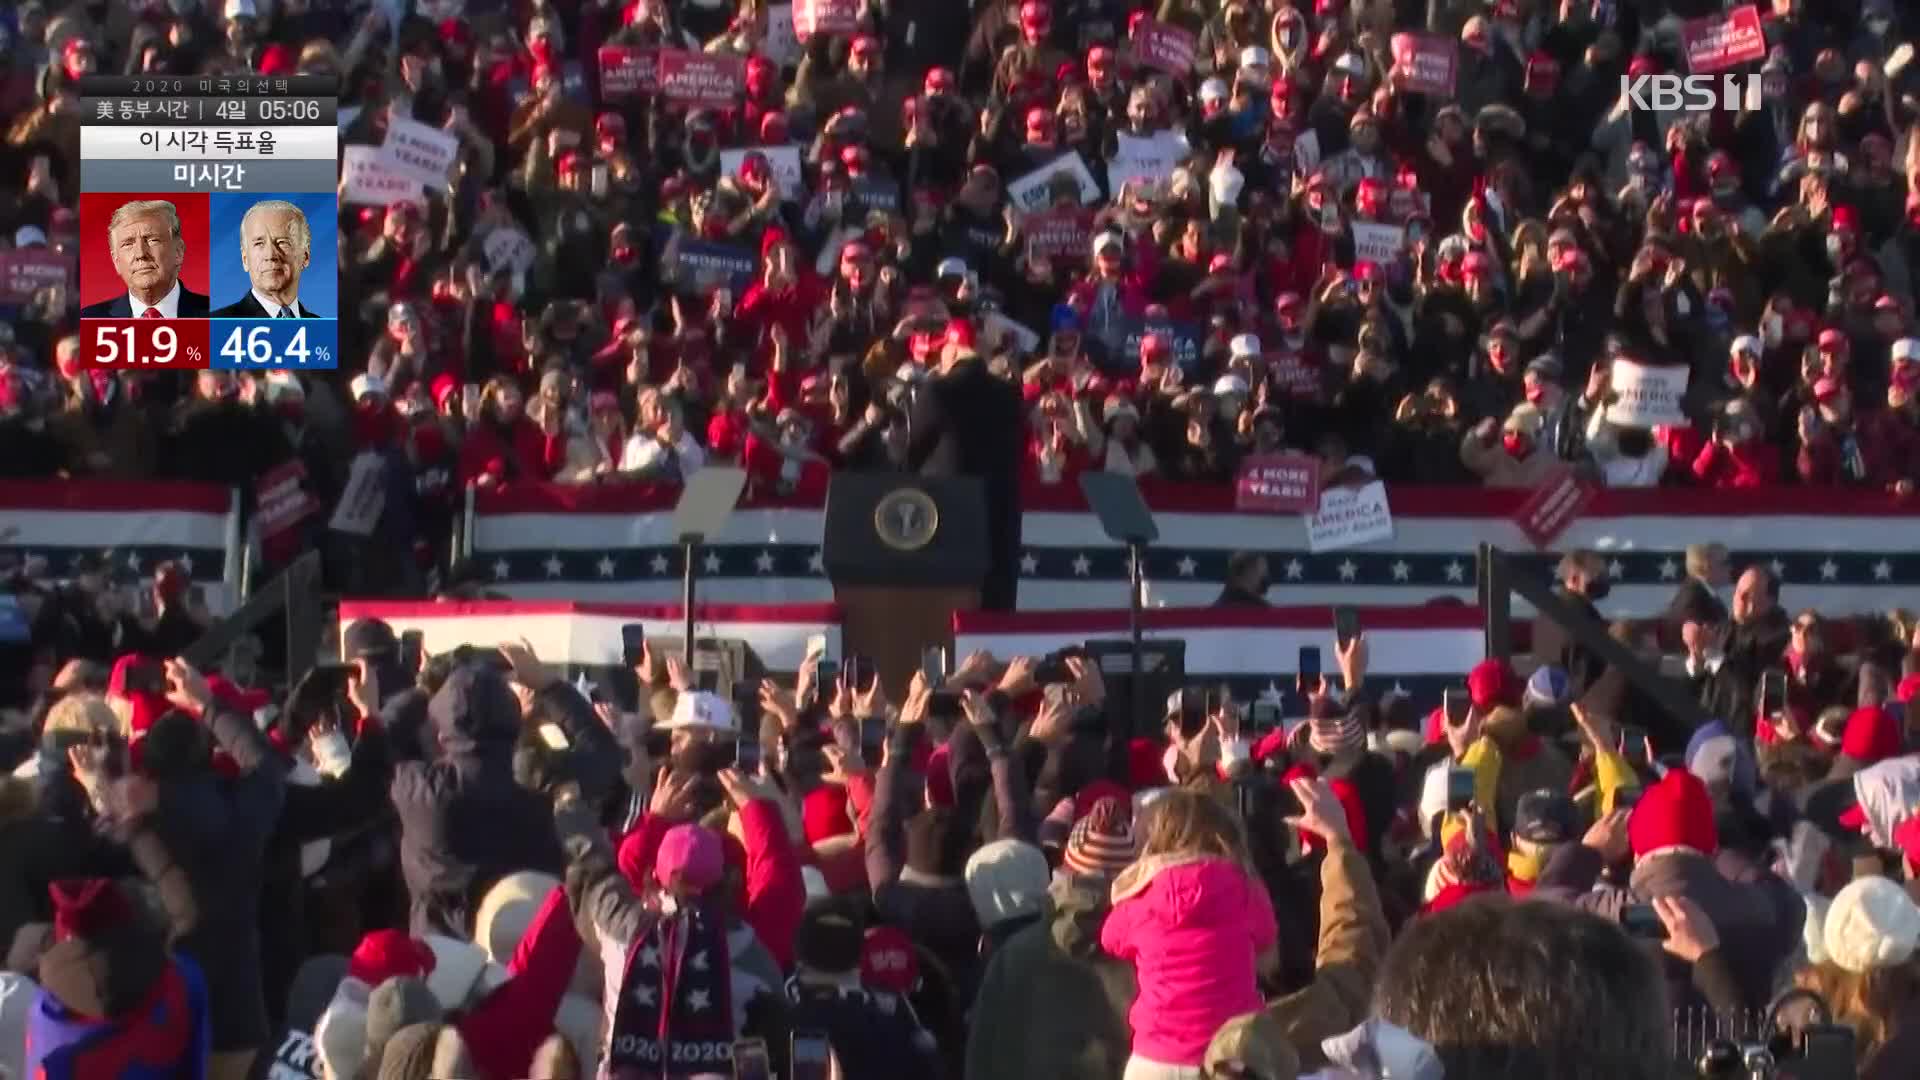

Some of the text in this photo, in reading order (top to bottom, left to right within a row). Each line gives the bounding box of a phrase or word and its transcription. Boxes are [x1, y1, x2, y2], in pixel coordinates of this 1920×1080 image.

[1690, 27, 1757, 52] AMERICA
[664, 73, 735, 88] AMERICA
[1248, 468, 1309, 482] 4 MORE
[1249, 483, 1307, 497] YEARS!
[1312, 500, 1384, 529] AMERICA
[672, 1042, 732, 1062] 2020
